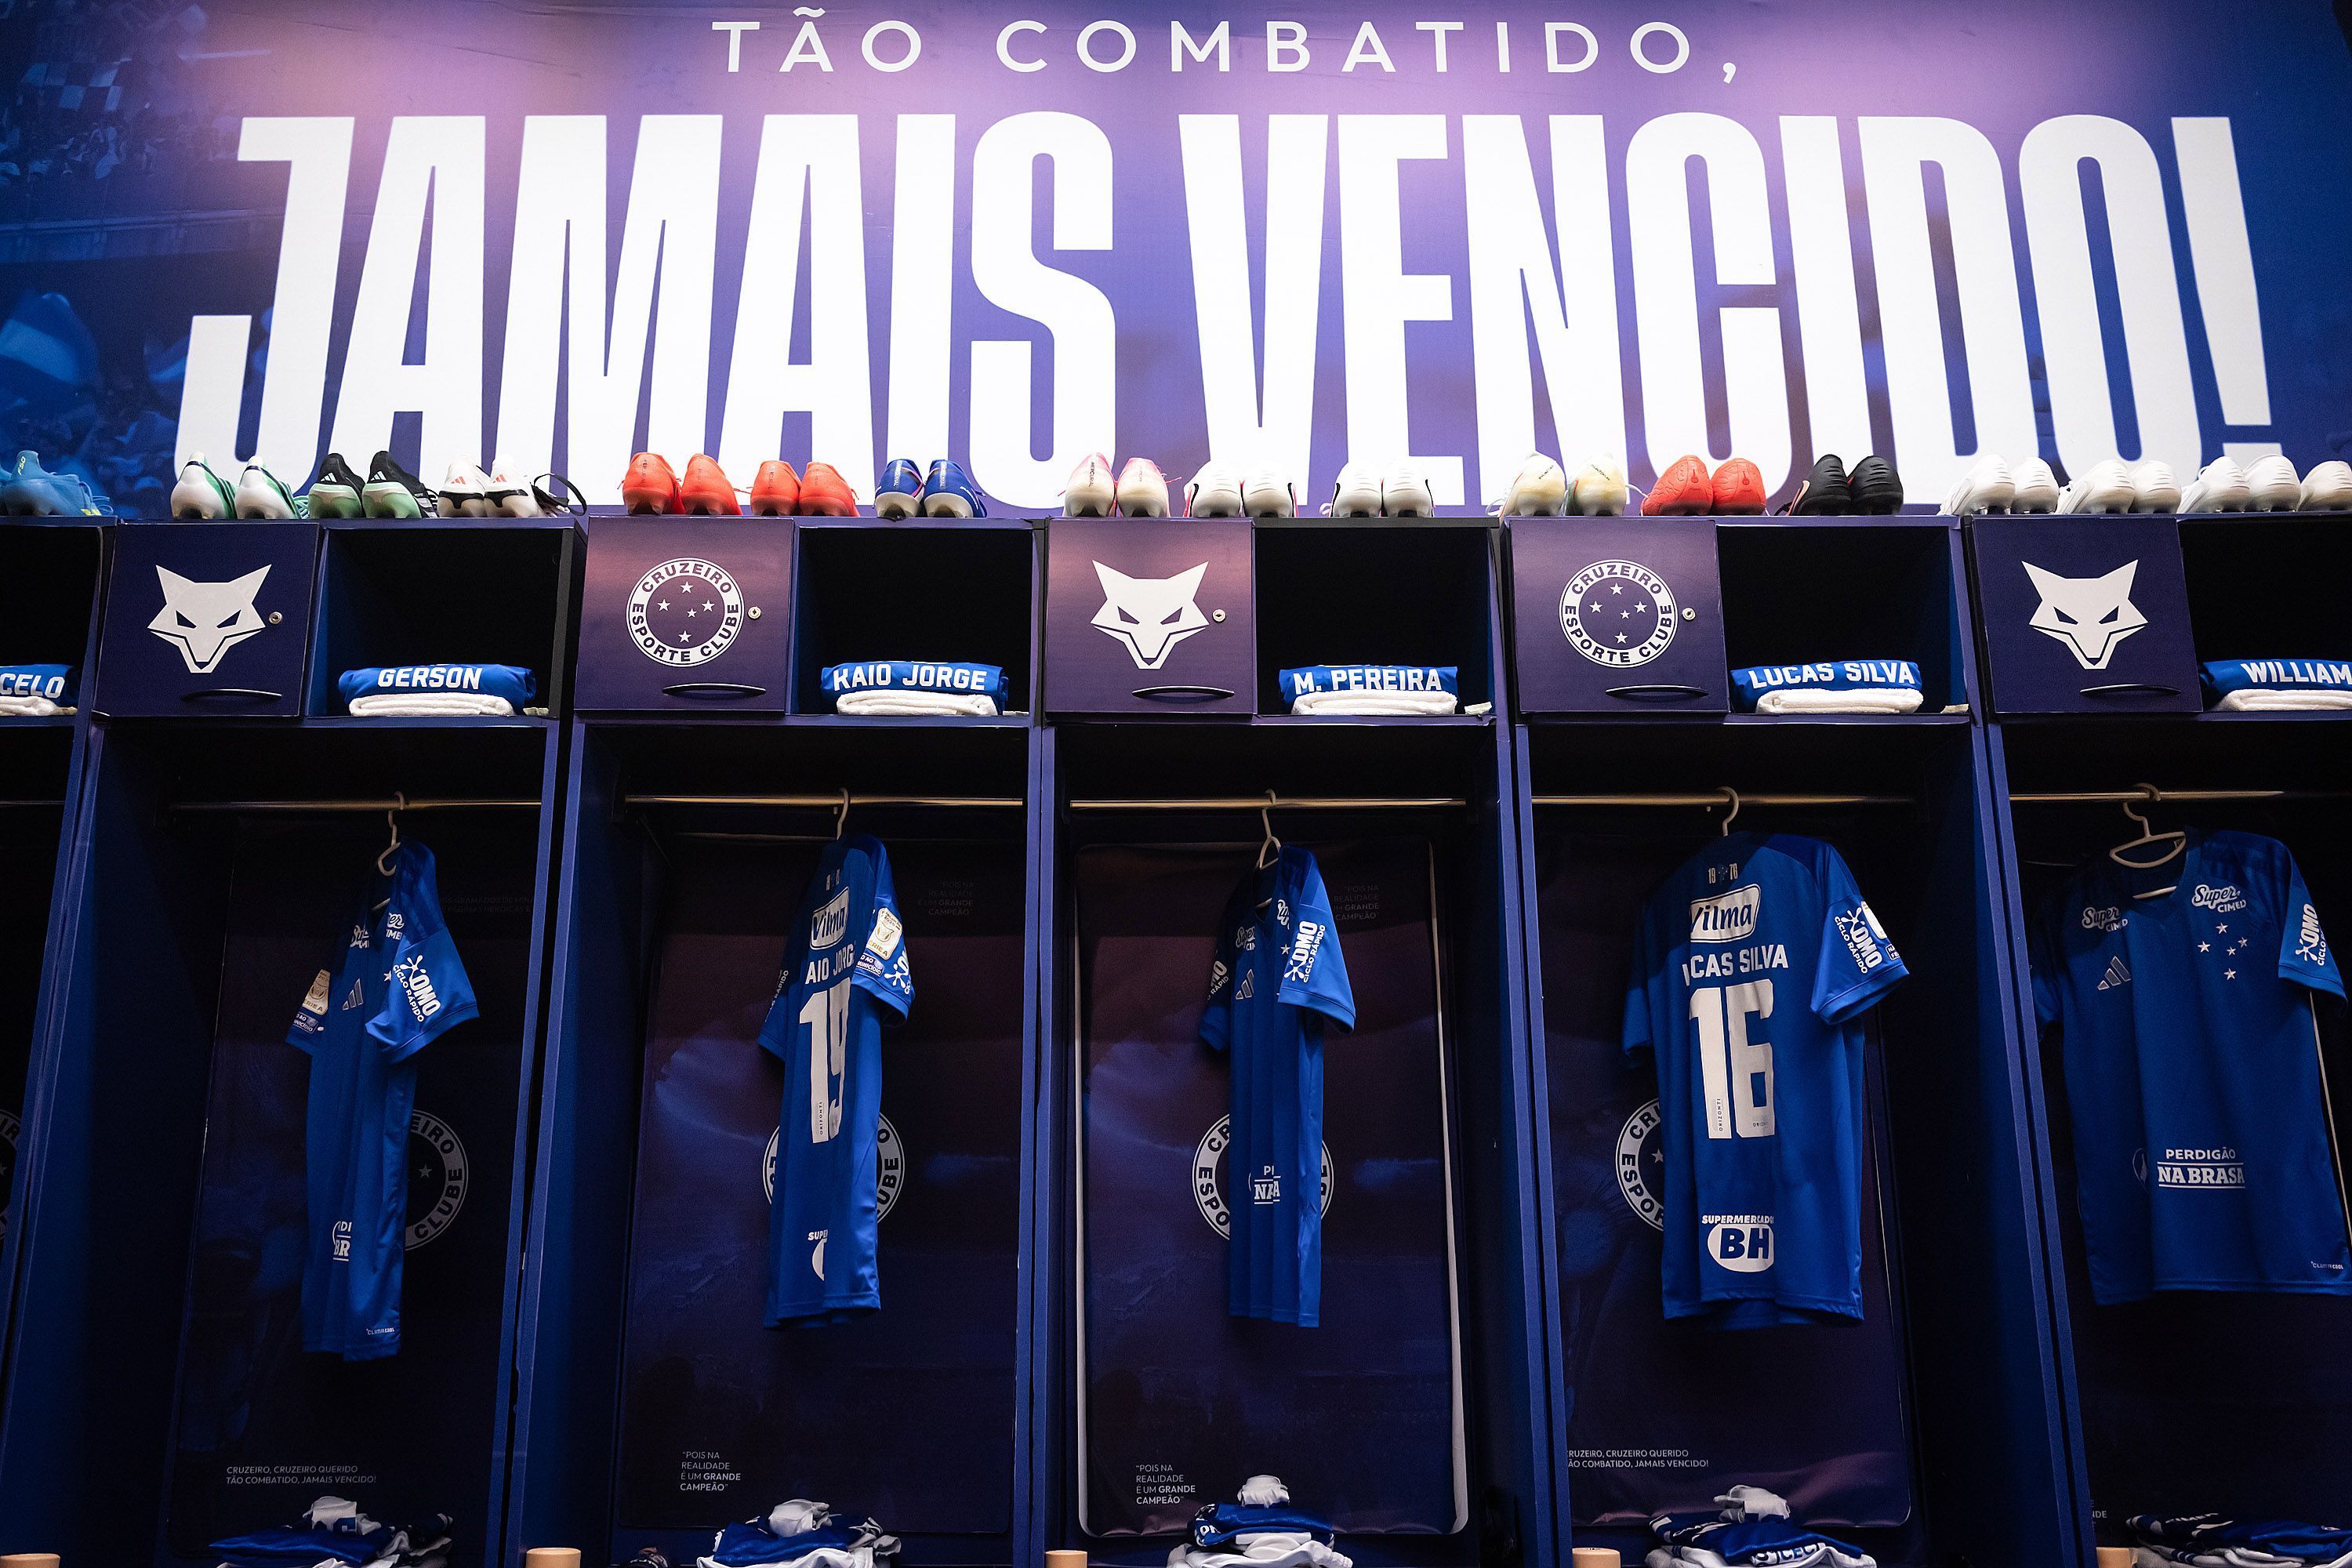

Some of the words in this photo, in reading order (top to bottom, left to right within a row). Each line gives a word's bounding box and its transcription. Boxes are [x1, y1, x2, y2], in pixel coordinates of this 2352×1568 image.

[712, 7, 921, 72] TÃO
[996, 20, 1736, 83] COMBATIDO,
[175, 111, 1116, 509] JAMAIS
[1178, 114, 2282, 508] VENCIDO!
[641, 563, 731, 593] CRUZEIRO
[1572, 564, 1662, 595] CRUZEIRO
[632, 603, 691, 662] ESPORTE
[700, 604, 739, 656] CLUBE
[1565, 605, 1630, 662] ESPORTE
[1639, 604, 1671, 657] CLUBE
[377, 667, 482, 689] GERSON
[833, 664, 891, 691] KAIO
[902, 664, 987, 691] JORGE
[1294, 672, 1322, 695] M.
[1330, 668, 1442, 691] PEREIRA
[1748, 662, 1835, 688] LUCAS
[1843, 662, 1915, 684] SILVA
[2240, 661, 2352, 685] WILLIAM
[2192, 884, 2240, 909] Super
[2217, 899, 2246, 913] CIMED
[813, 906, 845, 940] Vilma
[1690, 903, 1752, 934] Vilma
[2105, 918, 2128, 932] CIMD
[1293, 920, 1318, 963] OMO
[1835, 916, 1850, 942] CICLO
[1847, 942, 1867, 974] RÁPIDO
[1851, 926, 1882, 968] OMO
[2318, 942, 2326, 966] CICLO
[833, 943, 855, 976] JORG
[1303, 956, 1315, 983] CICLO
[1739, 943, 1789, 974] SILVA
[393, 964, 409, 989] CICLO
[406, 989, 424, 1022] RÁPIDO
[410, 974, 441, 1017] OMO
[799, 977, 851, 1144] 19
[1689, 978, 1776, 1139] 16
[2165, 1146, 2236, 1160] PERDIGÃO
[2158, 1166, 2186, 1184] NA
[2187, 1167, 2245, 1185] BRASA
[414, 1167, 463, 1240] CLUBE
[1719, 1228, 1769, 1259] BH
[681, 1461, 731, 1471] REALIDADE
[1160, 1464, 1174, 1472] NA
[1581, 1460, 1633, 1469] COMBATIDO,
[1634, 1459, 1666, 1468] JAMAIS
[1667, 1459, 1709, 1468] VENCIDO!
[1606, 1450, 1648, 1458] CRUZEIRO
[1649, 1449, 1689, 1458] QUERIDO
[226, 1475, 244, 1485] TÃO
[245, 1475, 300, 1486] COMBATIDO,
[301, 1475, 333, 1484] JAMAIS
[334, 1475, 377, 1484] VENCIDO!
[227, 1465, 272, 1475] CRUZEIRO,
[274, 1465, 317, 1474] CRUZEIRO
[318, 1465, 358, 1474] QUERIDO
[681, 1470, 686, 1480] É
[688, 1472, 702, 1480] UM
[703, 1472, 741, 1481] GRANDE
[1136, 1474, 1185, 1483] REALIDADE
[1136, 1483, 1142, 1494] É
[1143, 1485, 1157, 1494] UM
[1158, 1485, 1196, 1494] GRANDE
